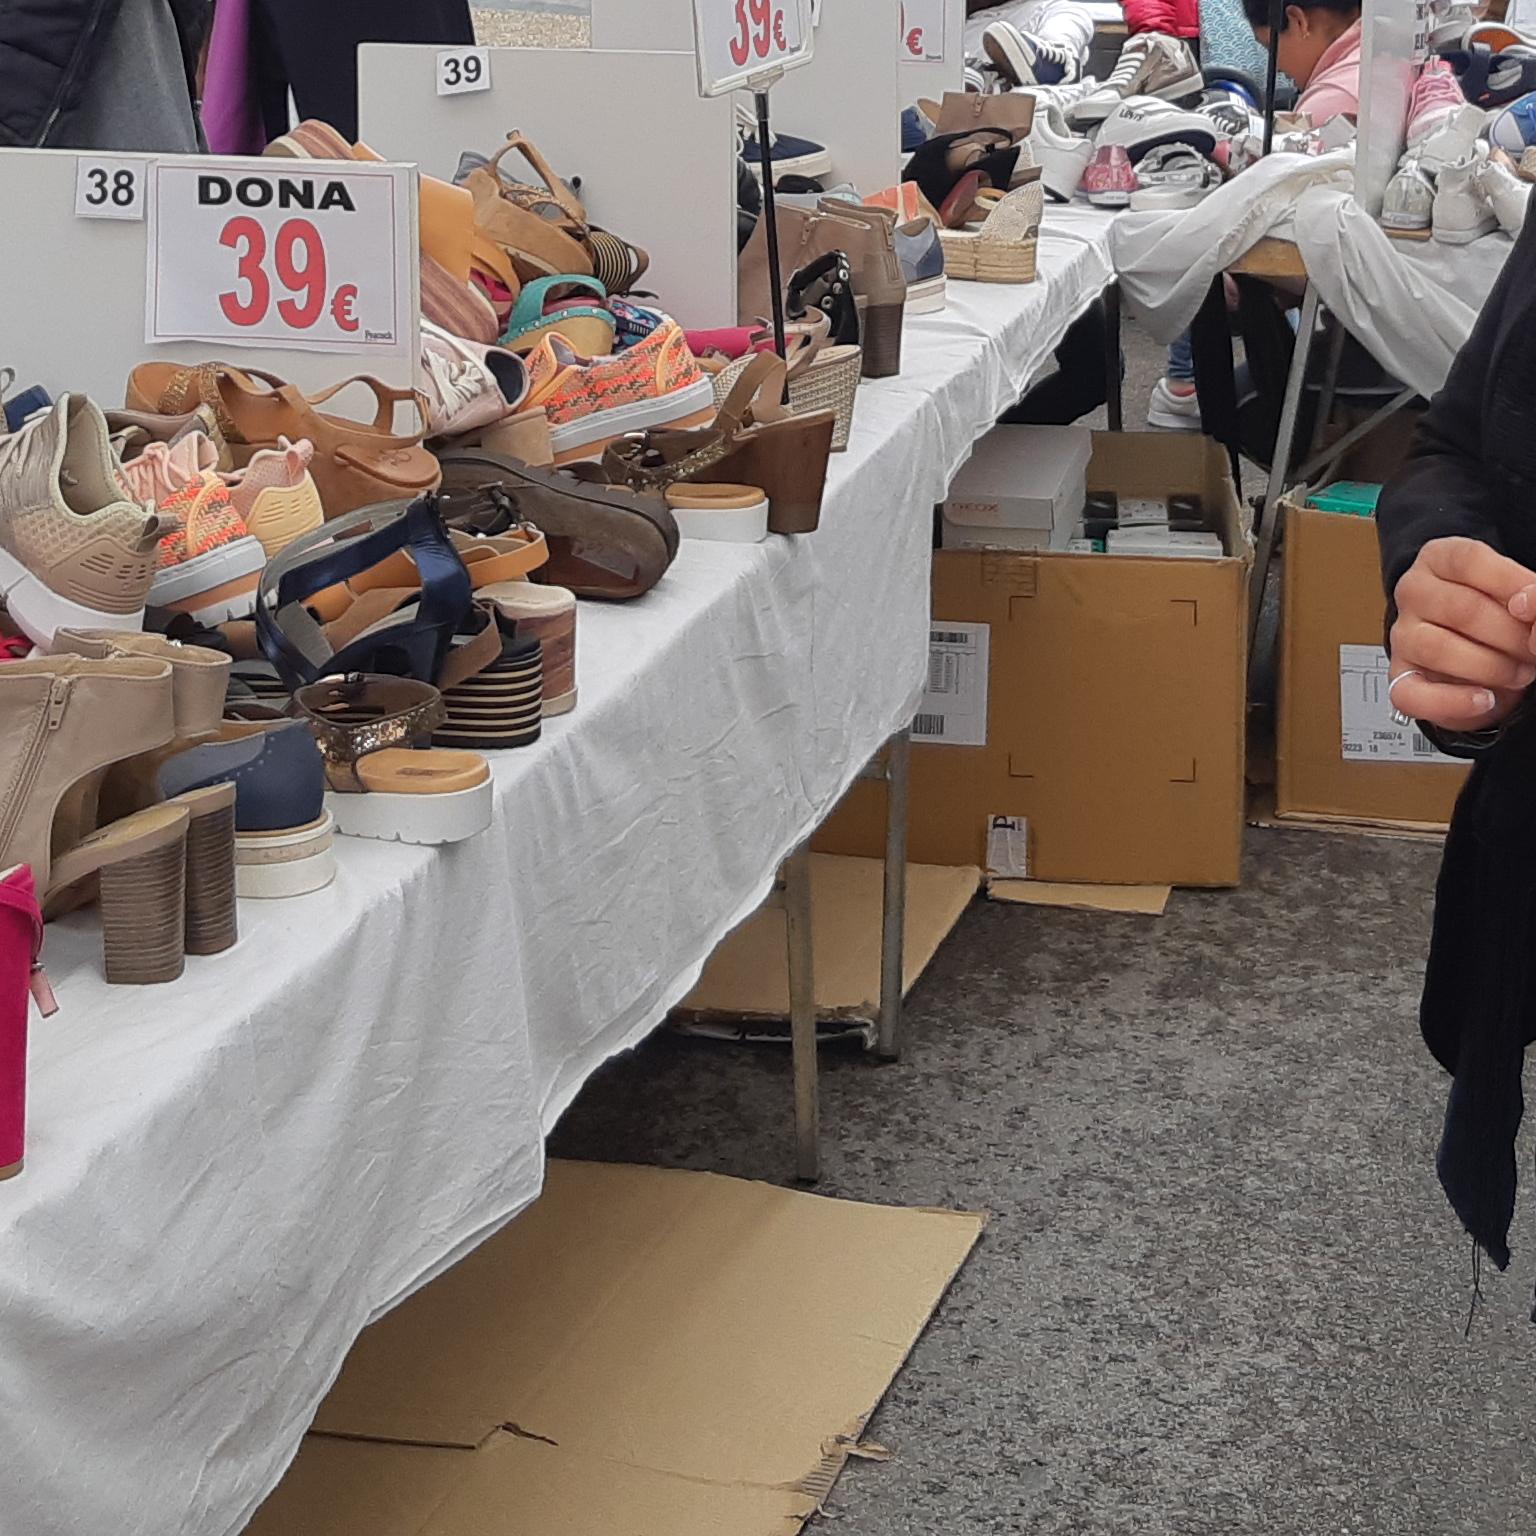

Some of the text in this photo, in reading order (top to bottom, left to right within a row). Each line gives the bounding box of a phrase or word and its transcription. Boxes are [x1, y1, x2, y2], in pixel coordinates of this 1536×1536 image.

[444, 55, 482, 86] 39
[85, 168, 135, 206] 38
[197, 174, 356, 212] DONA
